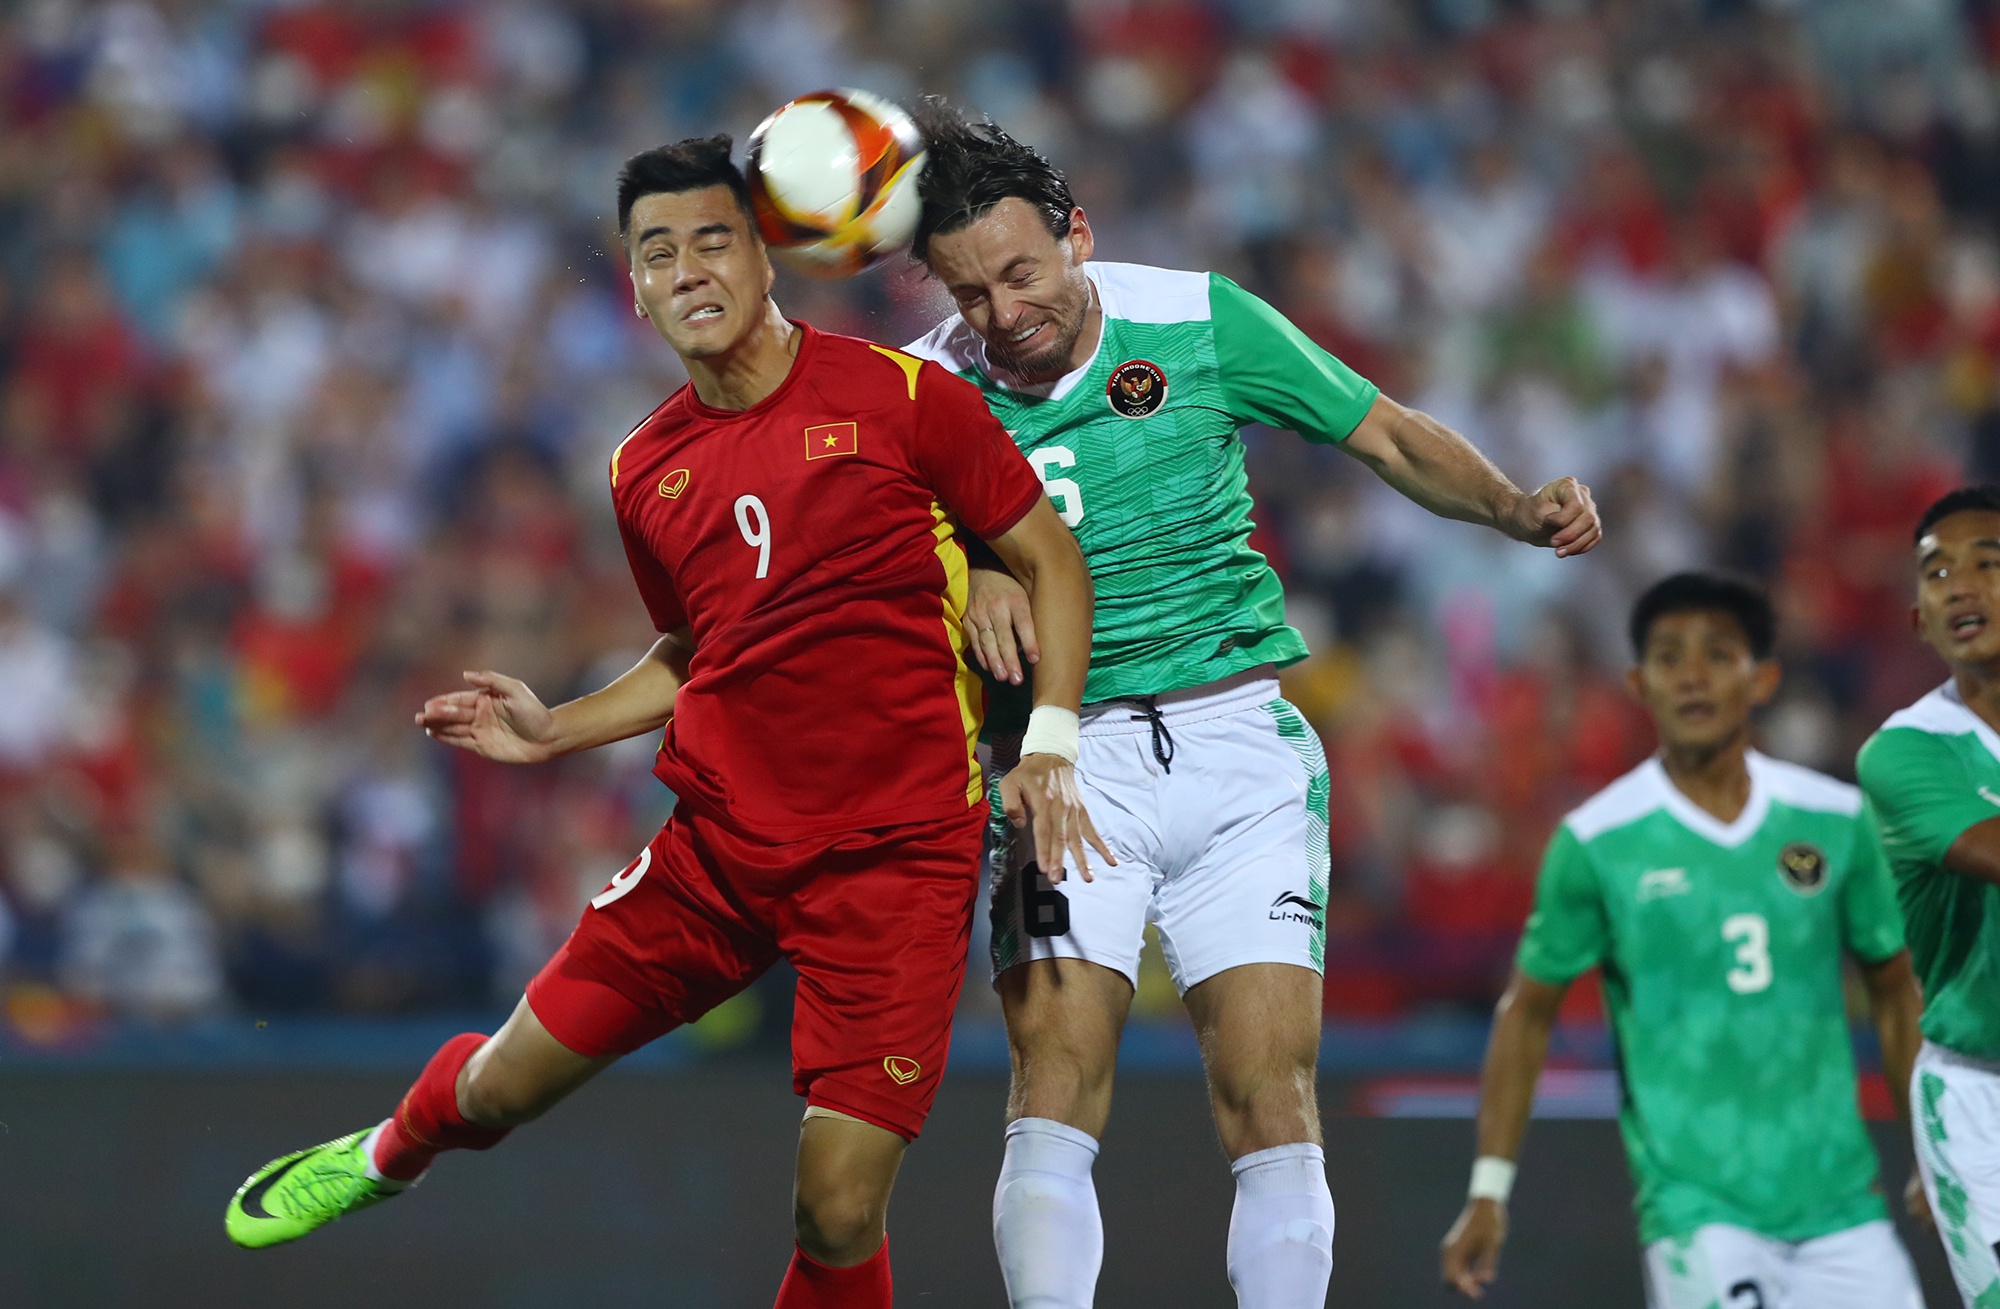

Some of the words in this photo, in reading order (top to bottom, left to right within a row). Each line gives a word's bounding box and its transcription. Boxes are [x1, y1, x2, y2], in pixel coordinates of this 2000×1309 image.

[1111, 372, 1121, 388] TIM
[1121, 364, 1161, 382] INDONESIA
[1027, 445, 1085, 527] 6
[734, 494, 771, 579] 9
[591, 846, 652, 910] 9
[1021, 861, 1071, 938] 6
[1269, 910, 1324, 931] LI-NING
[1721, 912, 1774, 996] 3
